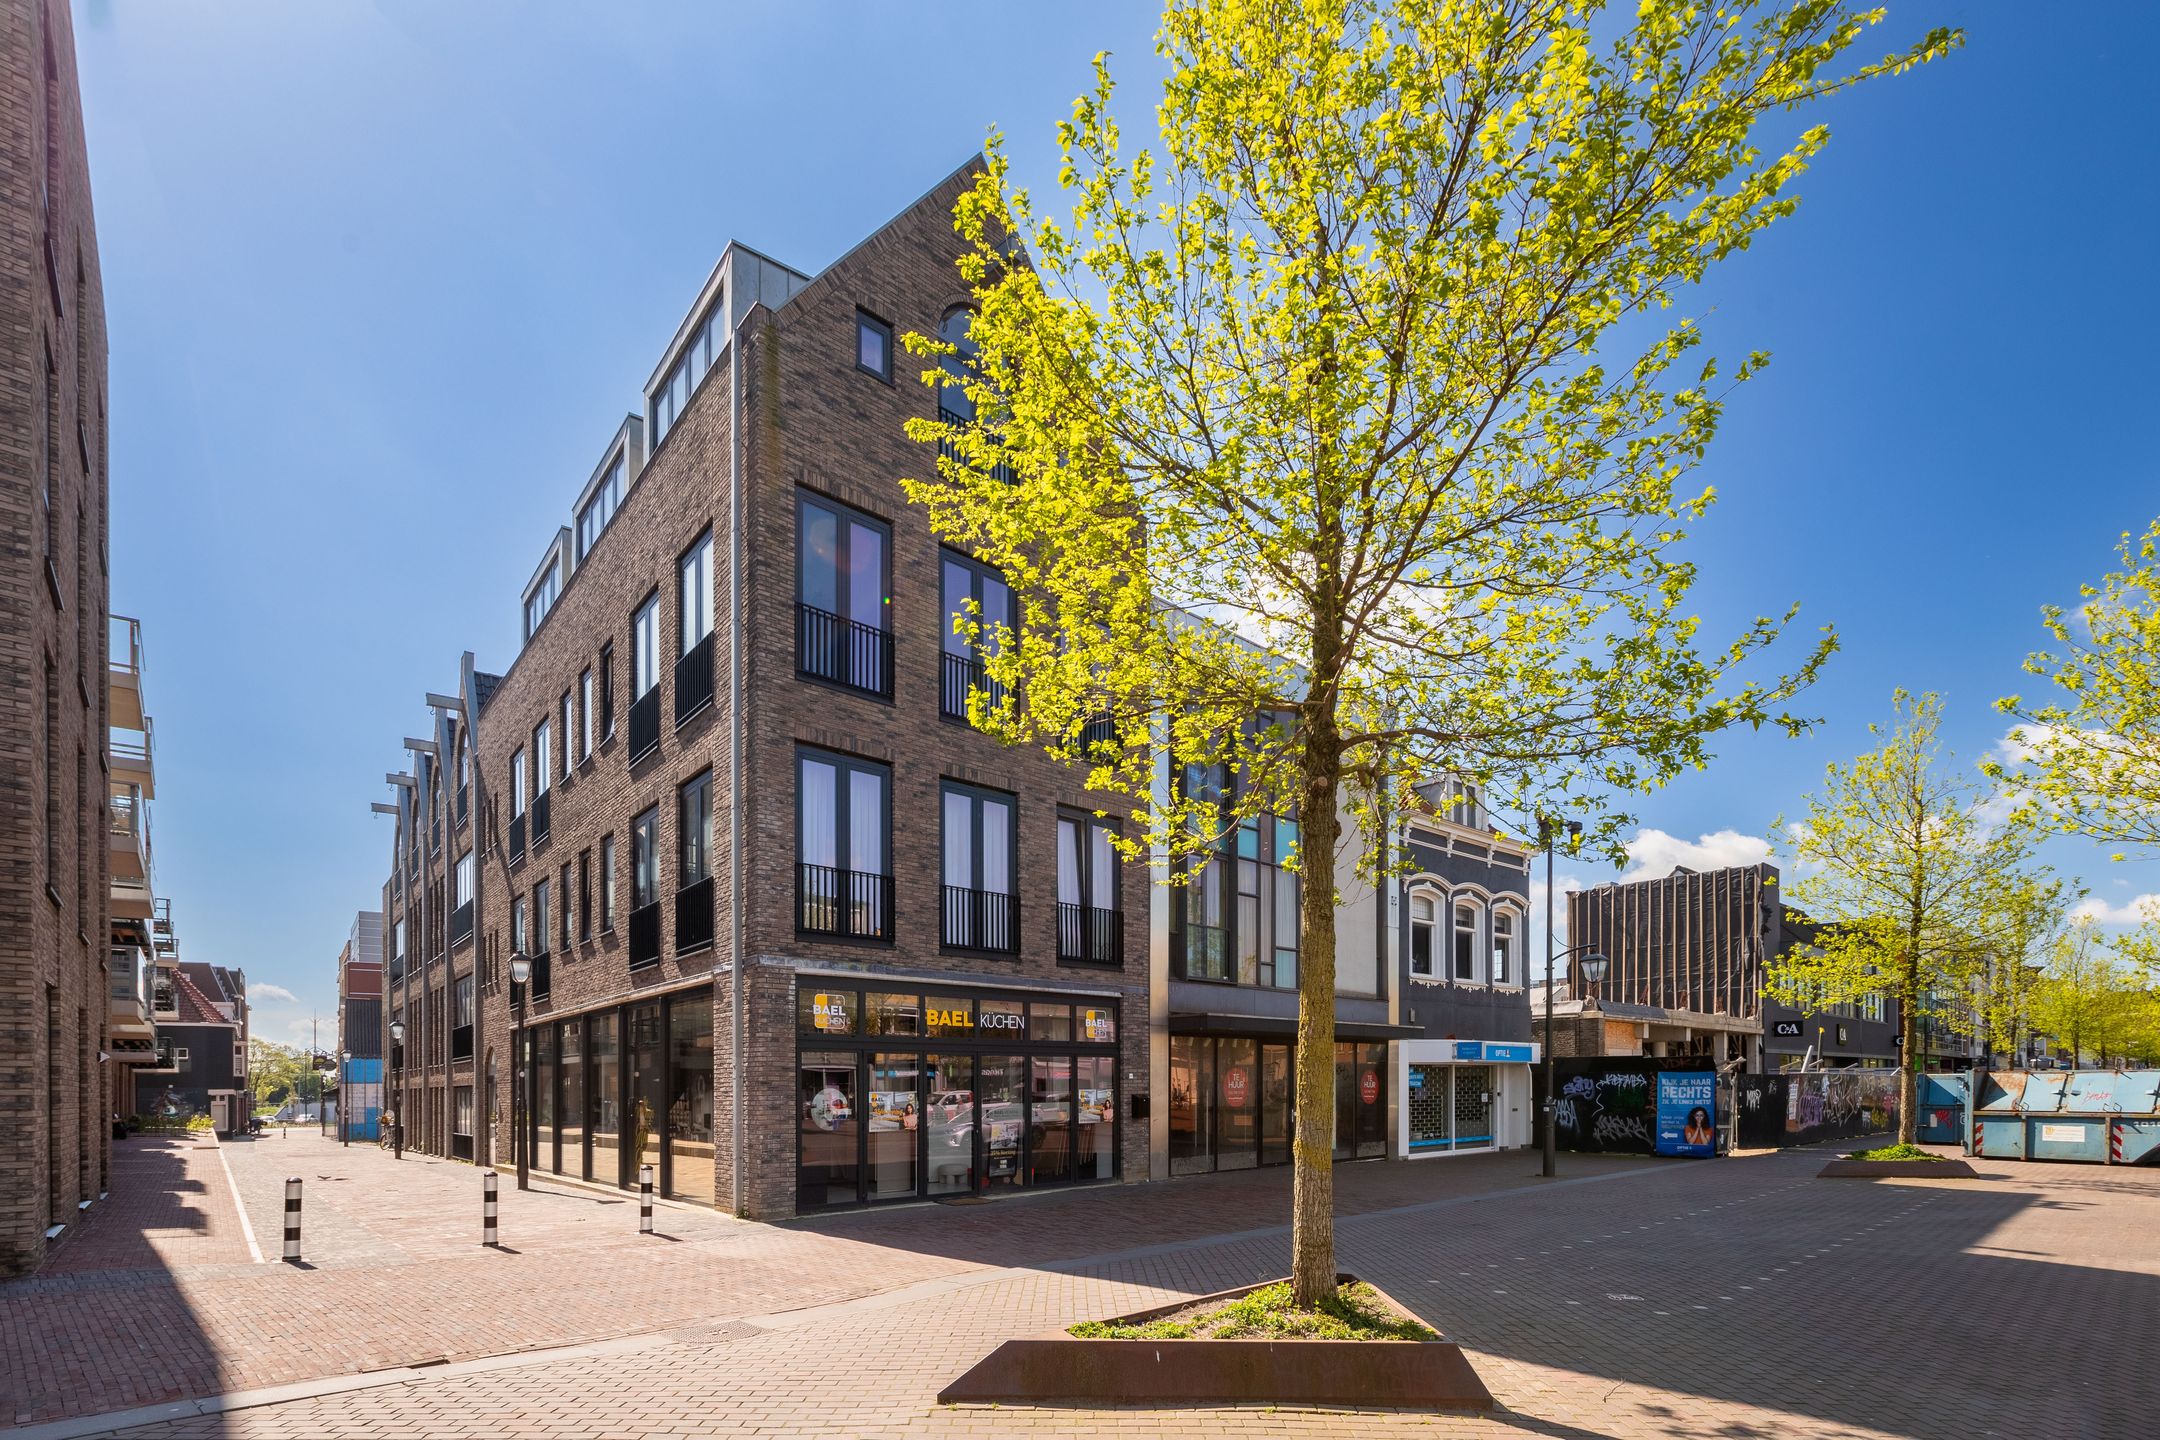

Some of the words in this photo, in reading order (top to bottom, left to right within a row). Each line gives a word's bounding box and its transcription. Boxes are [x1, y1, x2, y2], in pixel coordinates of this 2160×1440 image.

[812, 1003, 846, 1016] BAEL
[926, 1009, 974, 1027] BAEL
[980, 1012, 1025, 1029] KÜCHEN
[1085, 1019, 1107, 1028] BAEL
[1777, 1023, 1800, 1034] C&A
[1232, 1073, 1241, 1082] TE
[1367, 1074, 1373, 1082] TE
[1680, 1078, 1689, 1086] JE
[1690, 1078, 1711, 1086] NAAR
[1228, 1080, 1245, 1089] HUUR
[1363, 1081, 1376, 1089] HUUR
[1661, 1086, 1711, 1098] RECHTS
